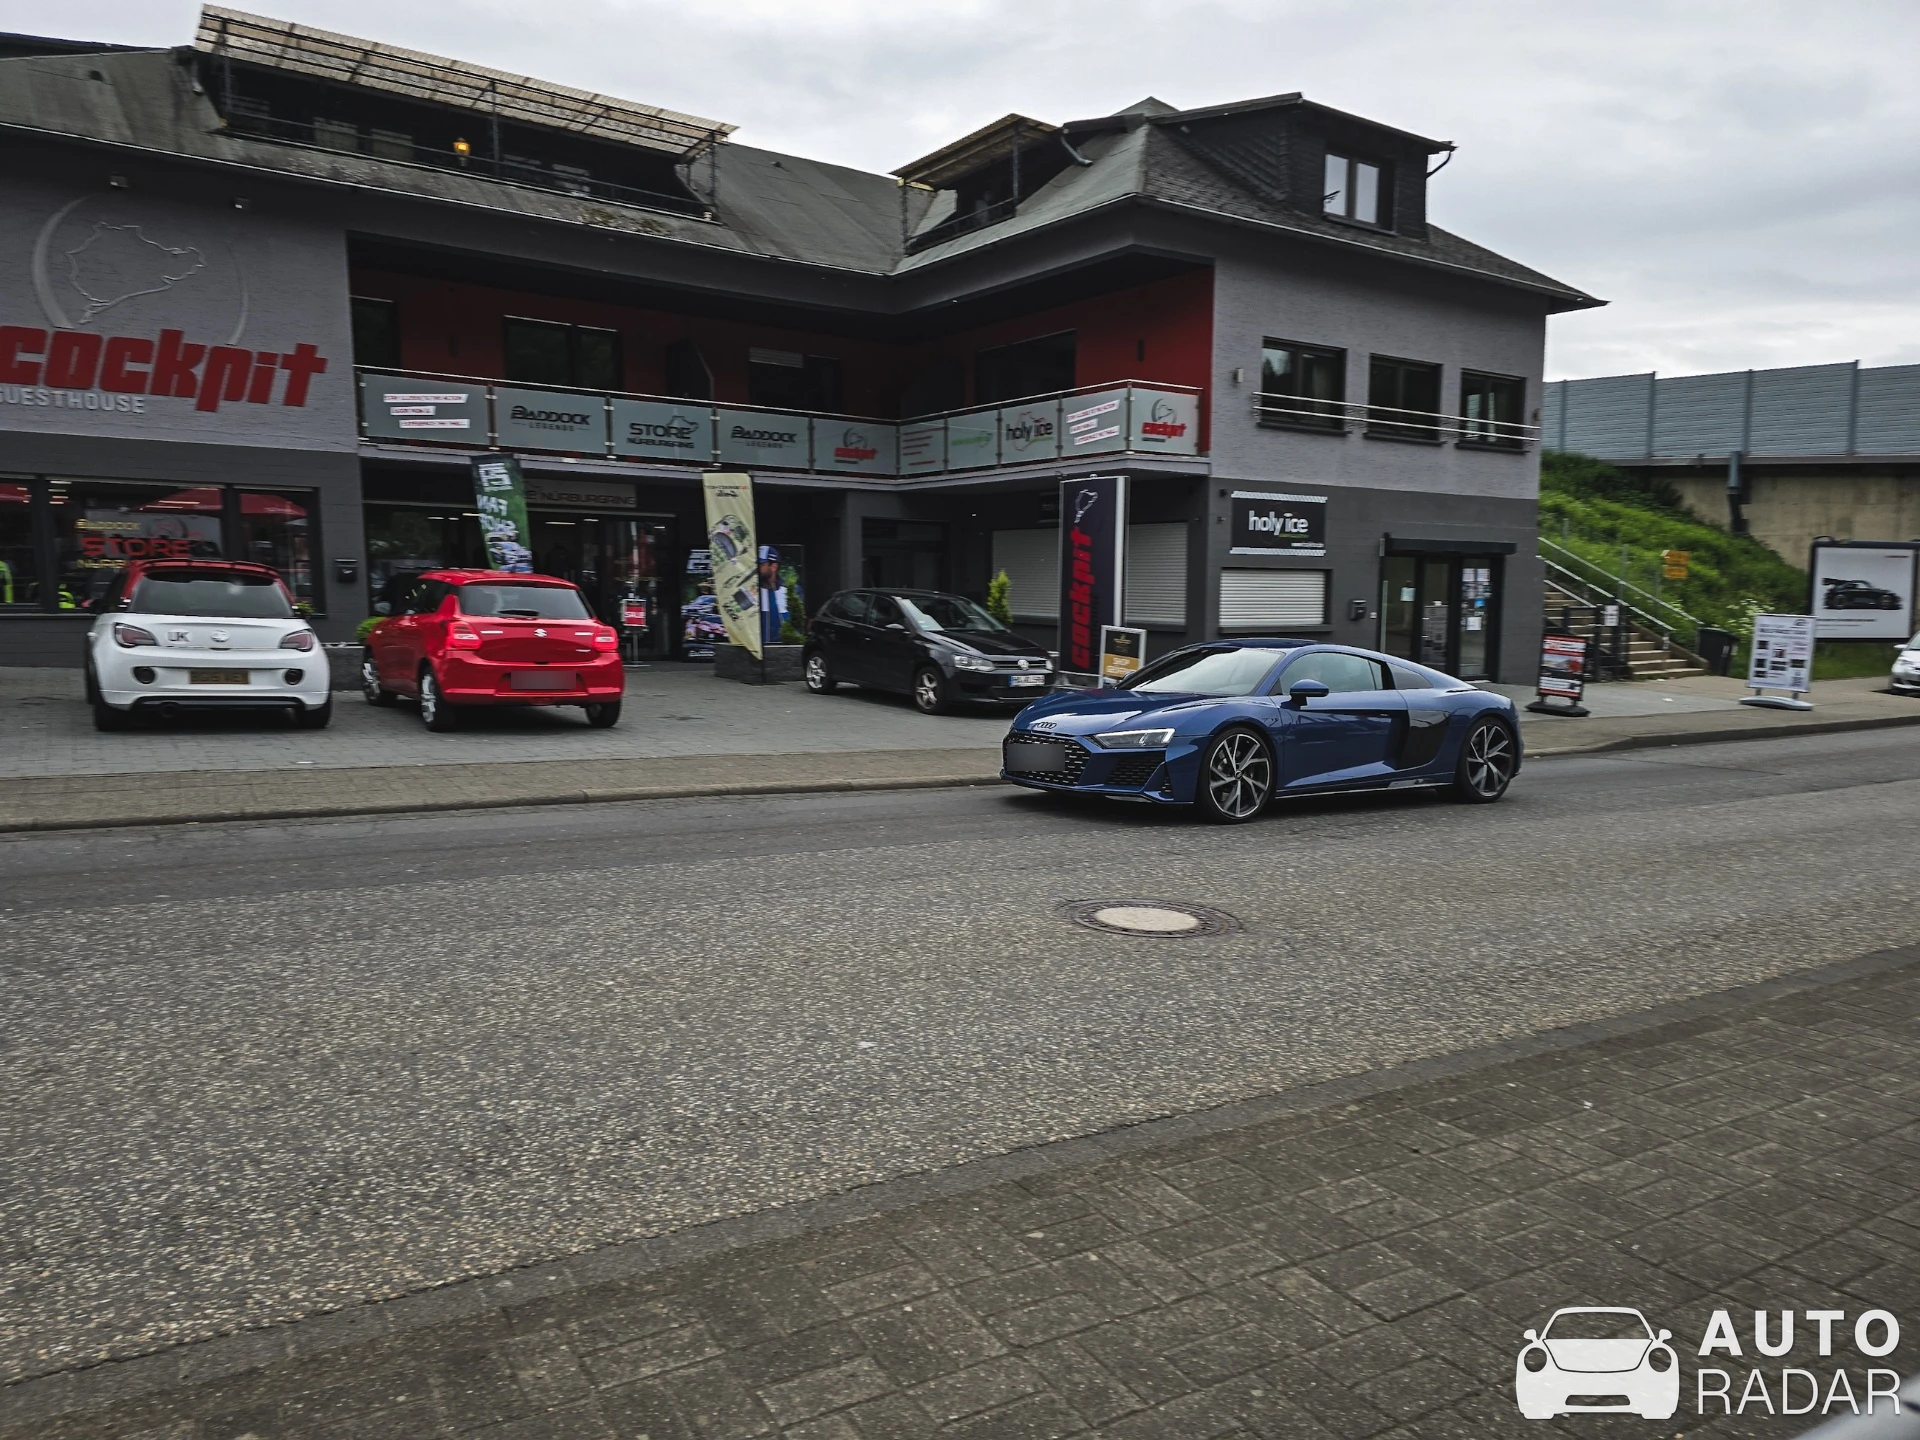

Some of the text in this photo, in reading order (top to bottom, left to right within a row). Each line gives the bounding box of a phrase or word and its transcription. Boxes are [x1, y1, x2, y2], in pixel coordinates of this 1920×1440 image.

[0, 325, 328, 412] cockpit
[0, 386, 146, 413] UESTHOUSE
[511, 405, 592, 425] PADDOCK
[628, 423, 692, 439] STORE
[1006, 421, 1033, 441] holy
[1248, 510, 1309, 536] holy ice
[81, 537, 192, 557] STORE
[1068, 526, 1096, 669] cockpit
[167, 631, 191, 643] UK
